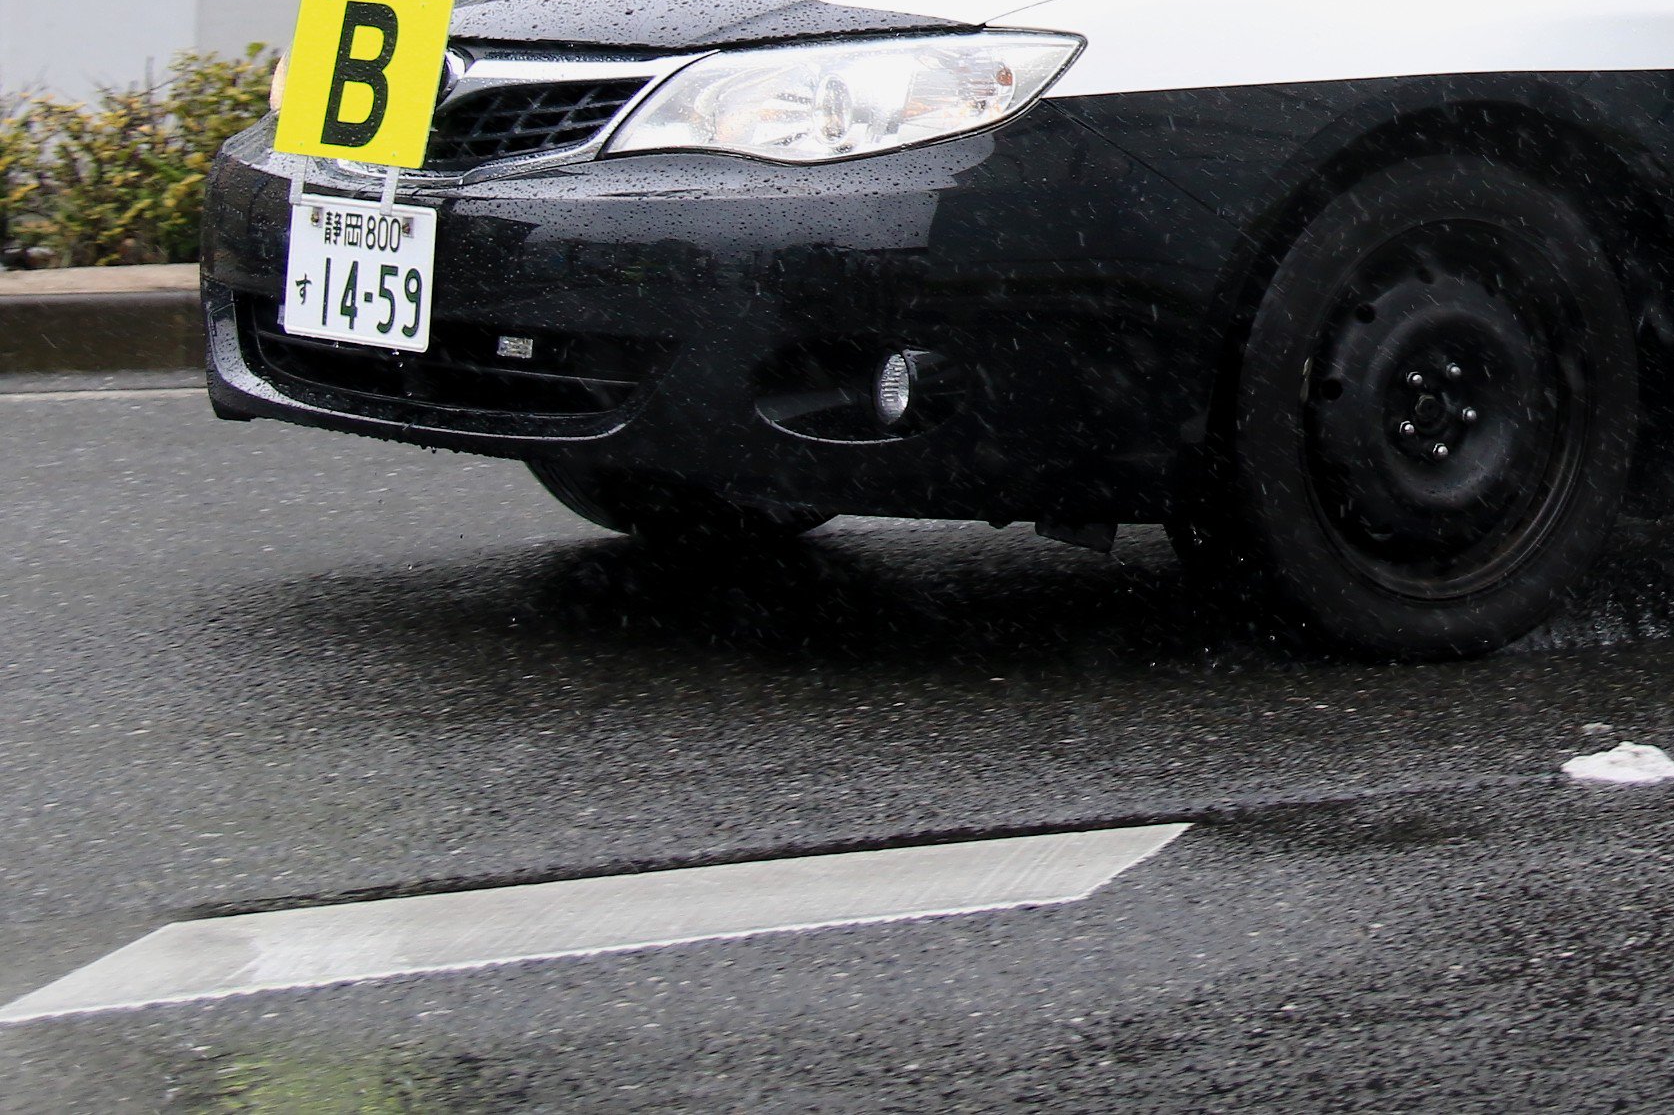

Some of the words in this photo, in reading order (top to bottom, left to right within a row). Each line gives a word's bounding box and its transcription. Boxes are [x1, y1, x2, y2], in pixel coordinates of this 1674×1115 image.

[320, 0, 399, 148] B
[295, 273, 313, 305] す
[321, 257, 424, 338] 14-59
